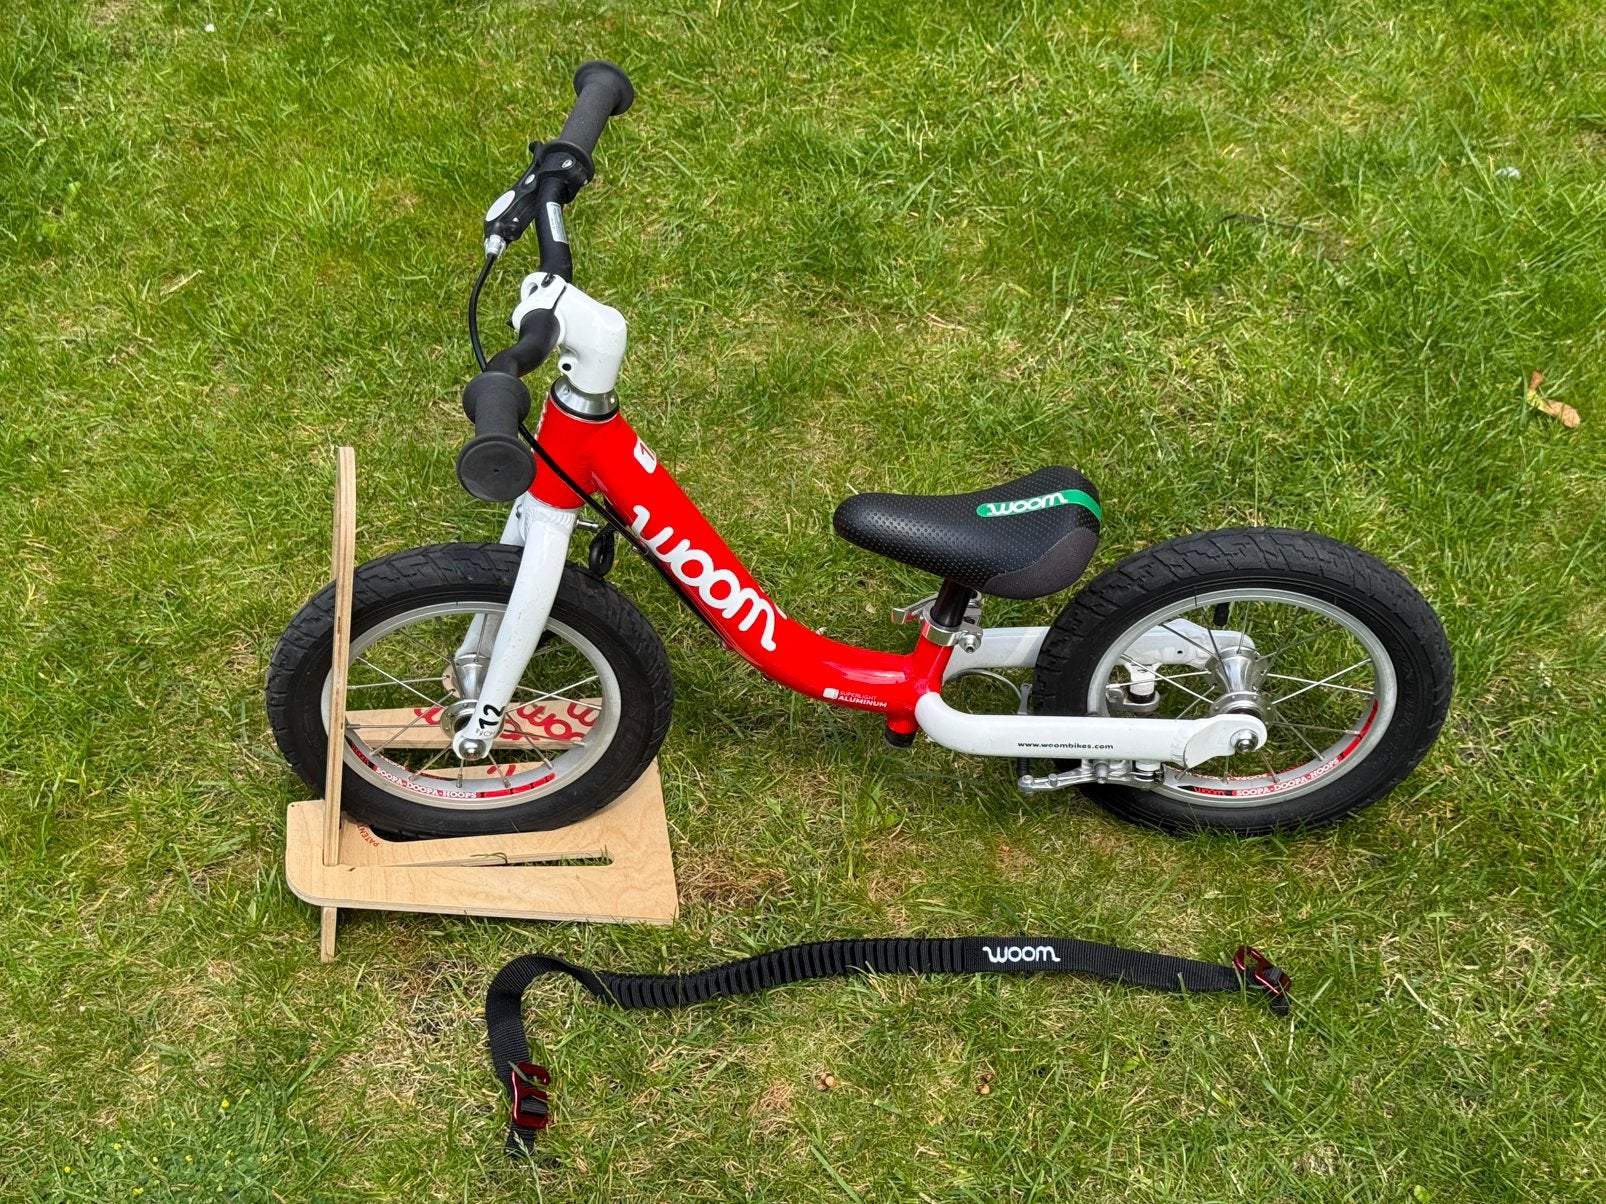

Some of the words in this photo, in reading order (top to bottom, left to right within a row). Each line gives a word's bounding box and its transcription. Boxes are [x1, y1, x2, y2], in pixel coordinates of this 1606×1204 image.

[985, 491, 1069, 516] woom
[631, 504, 777, 652] woom
[837, 695, 888, 708] ALUMINUM
[839, 689, 878, 701] SUPERLIGHT
[478, 703, 506, 730] 12
[1017, 741, 1114, 750] www.woombikes.com
[982, 946, 1061, 963] woom
